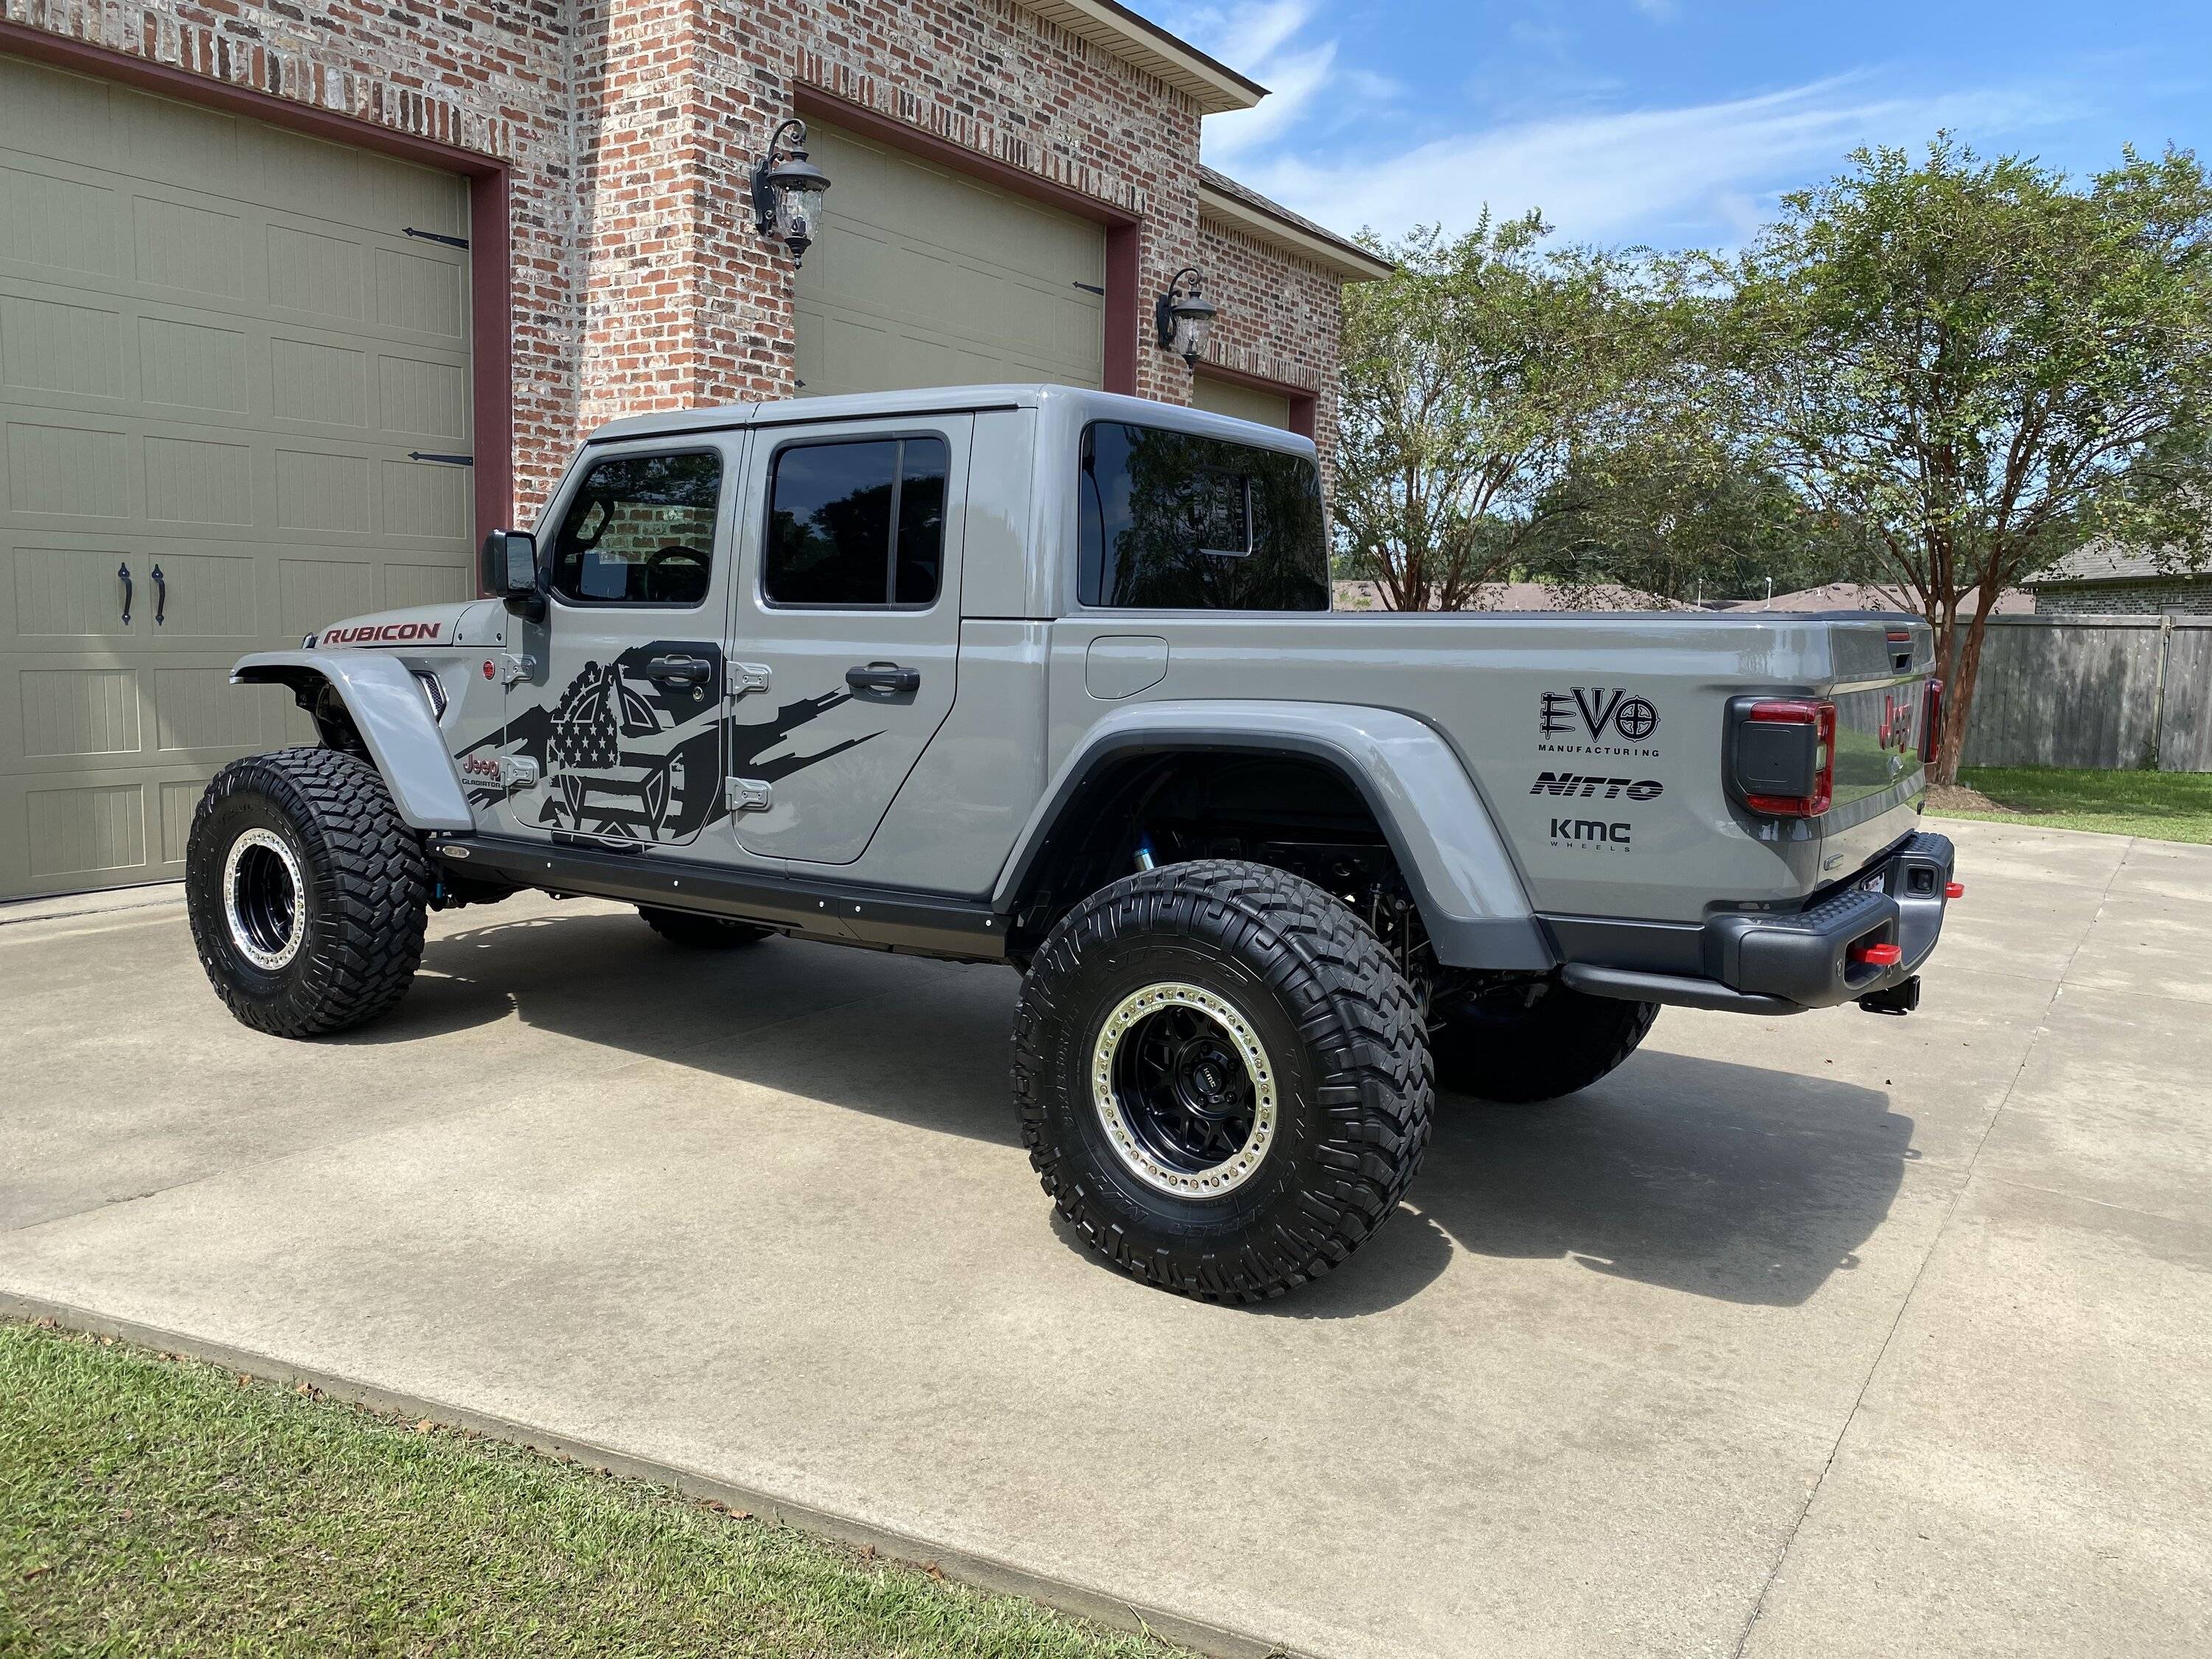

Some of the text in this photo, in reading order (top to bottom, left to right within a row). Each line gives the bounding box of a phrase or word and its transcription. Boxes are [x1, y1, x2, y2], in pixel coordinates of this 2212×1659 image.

[323, 622, 442, 645] RUBICON
[1540, 686, 1660, 743] EVO
[1879, 695, 1911, 754] Jeep
[1538, 744, 1660, 757] MANUFACTURING
[462, 754, 499, 780] Jeep
[462, 778, 501, 788] GLADIATOR
[1529, 771, 1664, 801] NITTO
[1551, 818, 1631, 844] KMC
[1551, 841, 1630, 853] WHEELS
